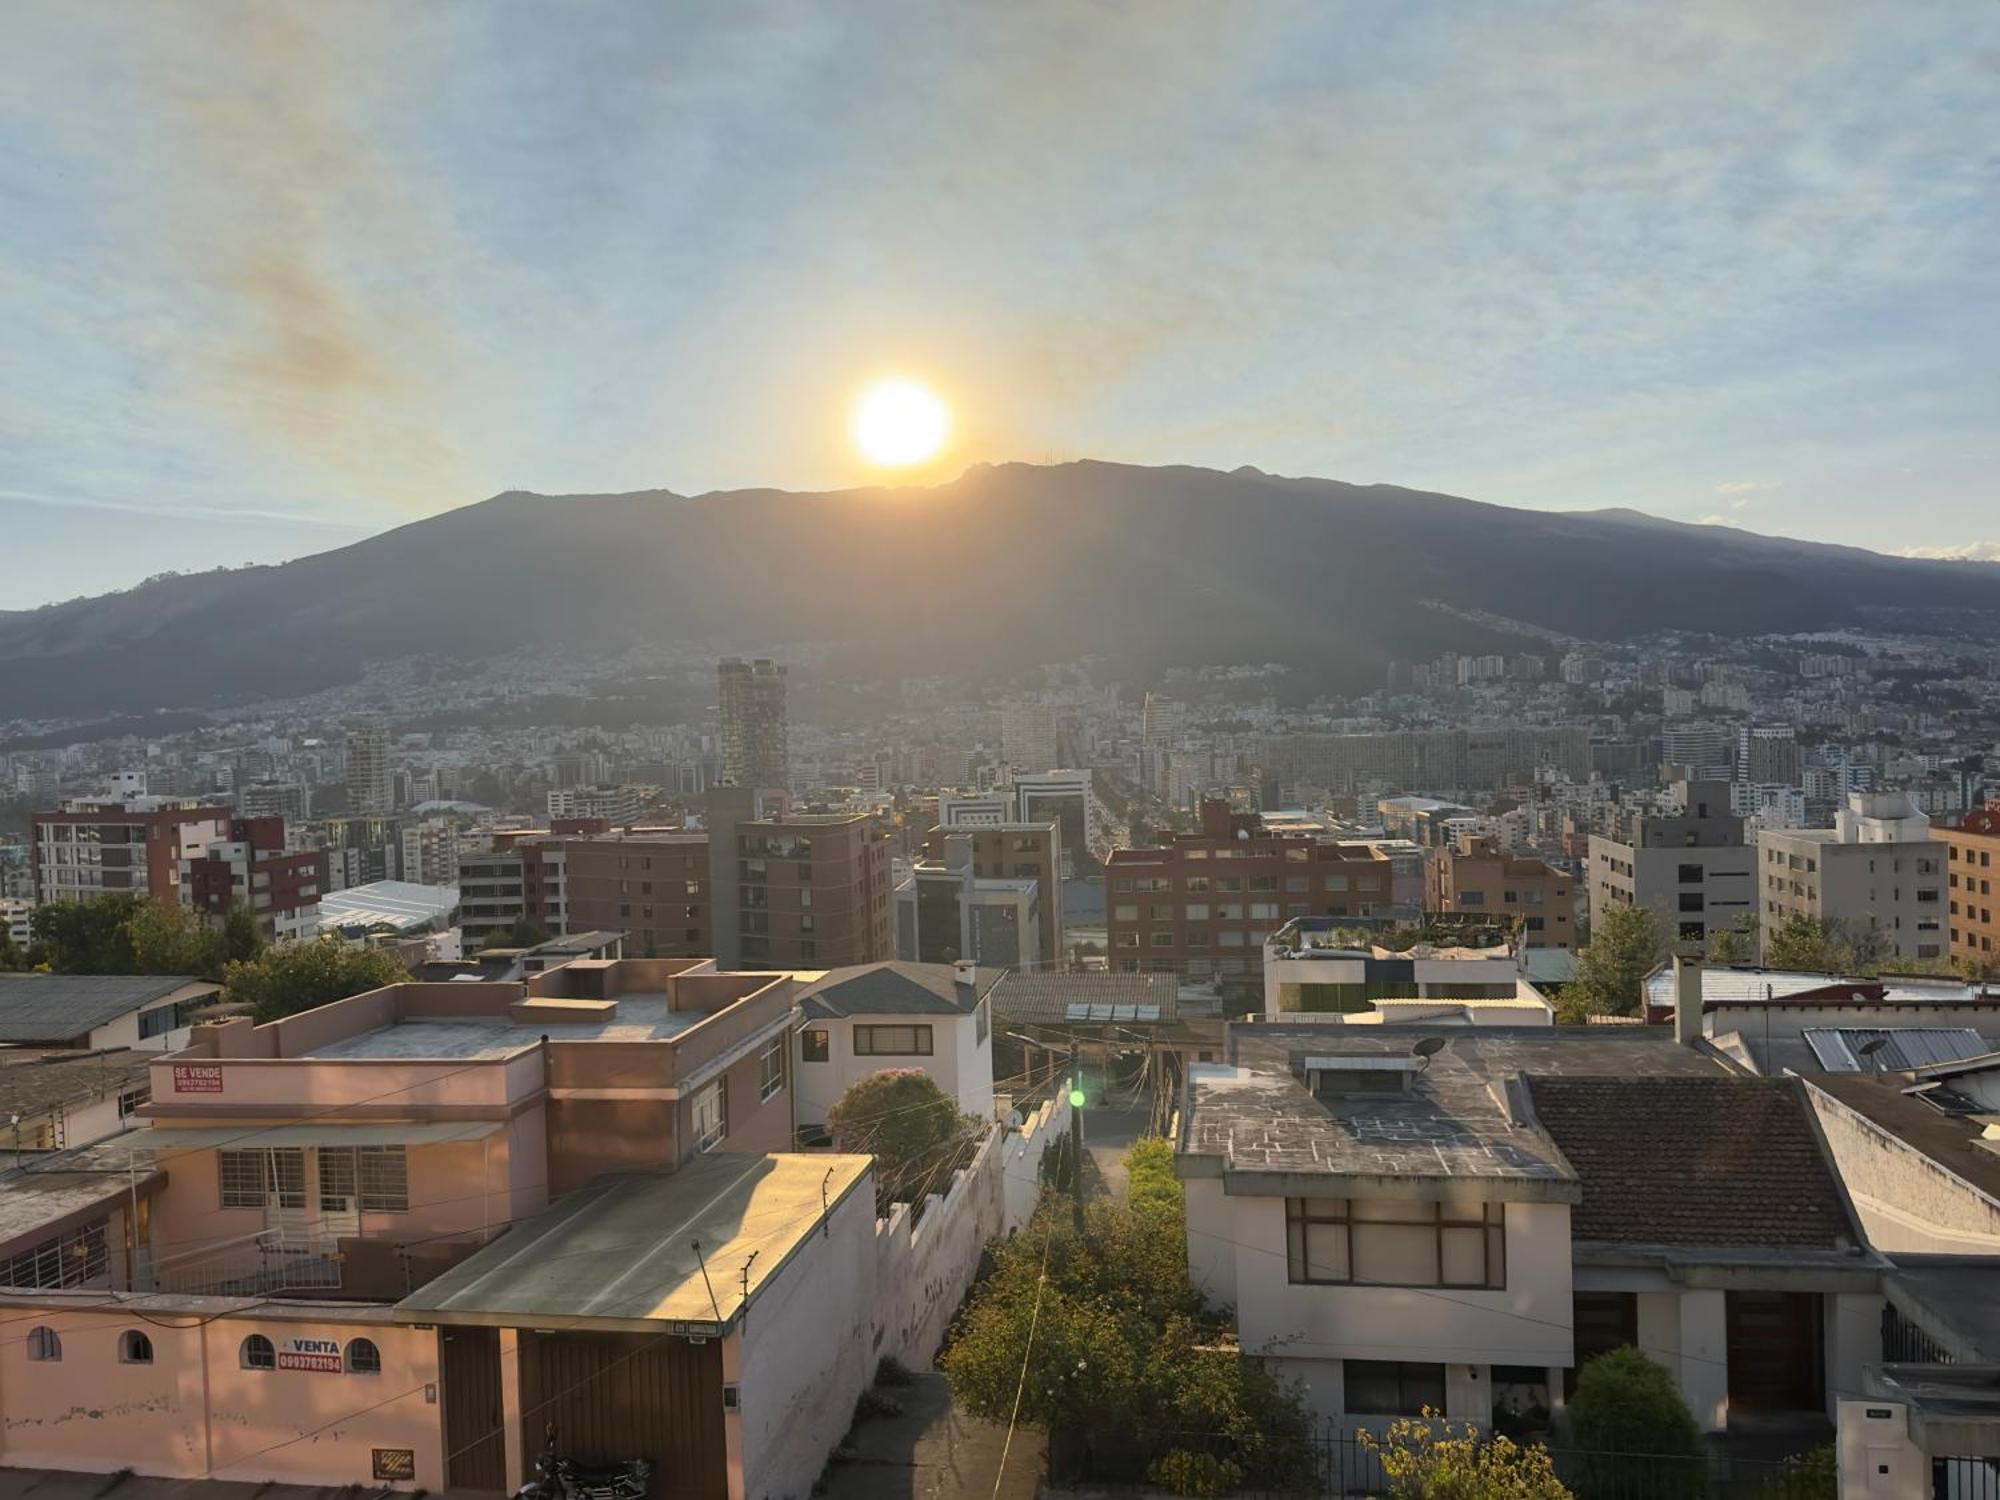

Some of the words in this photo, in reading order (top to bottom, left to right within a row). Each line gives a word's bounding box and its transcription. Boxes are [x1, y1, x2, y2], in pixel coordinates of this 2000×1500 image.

[175, 1067, 187, 1078] SE
[190, 1067, 221, 1078] VENDE
[294, 1339, 340, 1354] VENTA
